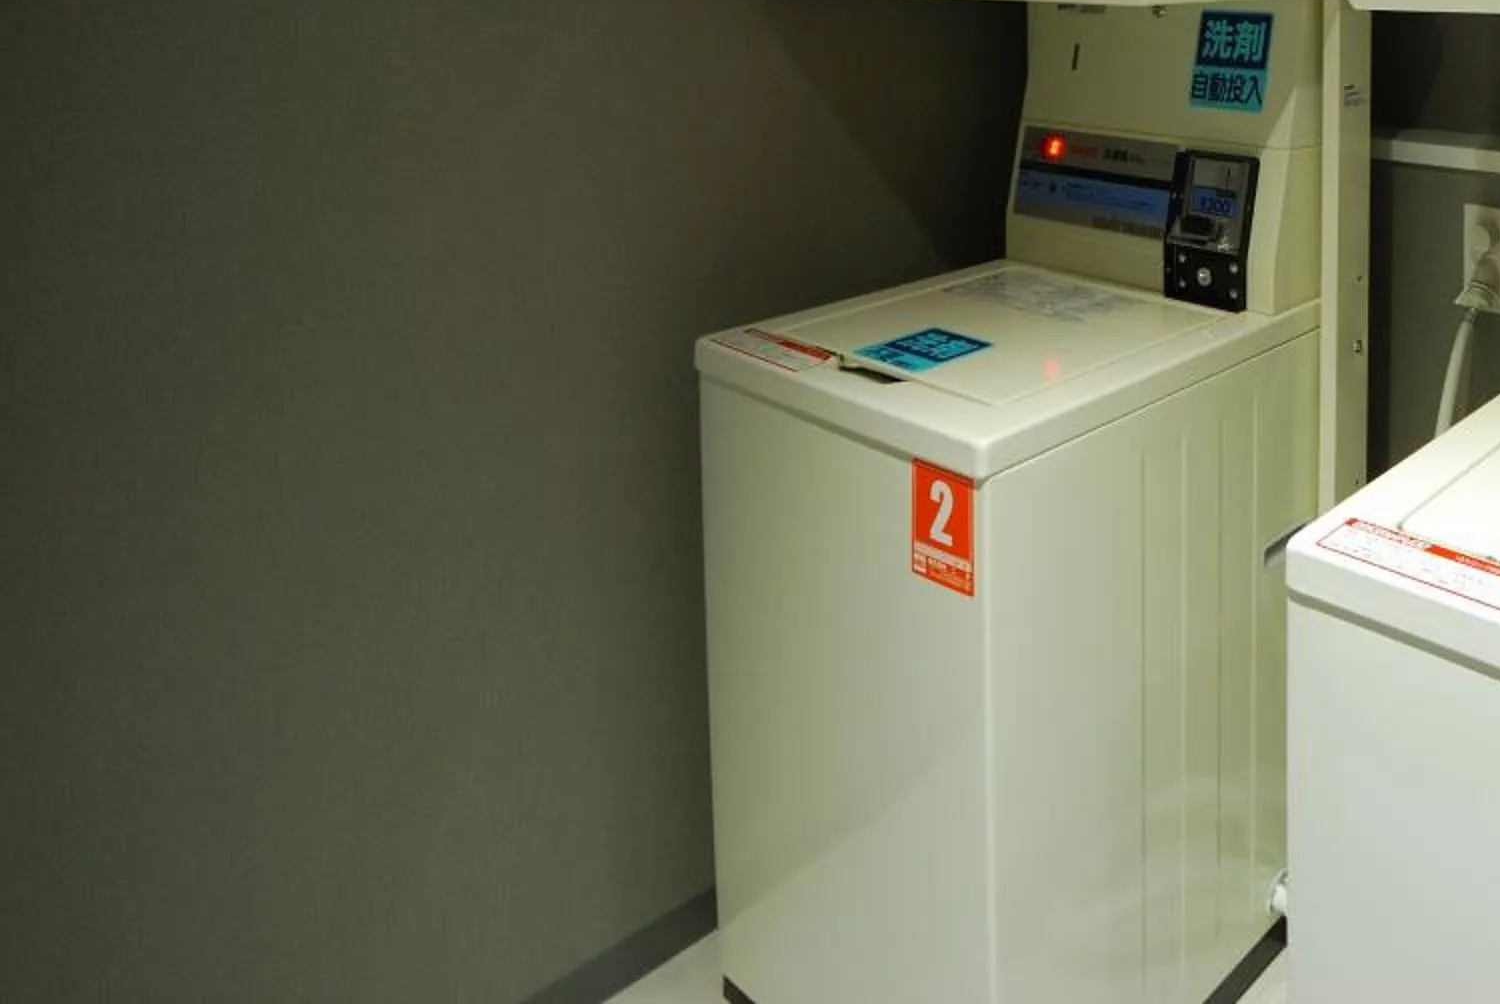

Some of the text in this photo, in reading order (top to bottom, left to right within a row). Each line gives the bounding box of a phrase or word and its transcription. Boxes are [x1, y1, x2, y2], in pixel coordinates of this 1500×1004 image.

[1202, 19, 1267, 61] 洗剤
[1191, 72, 1263, 107] 自動投入
[929, 479, 954, 548] 2
